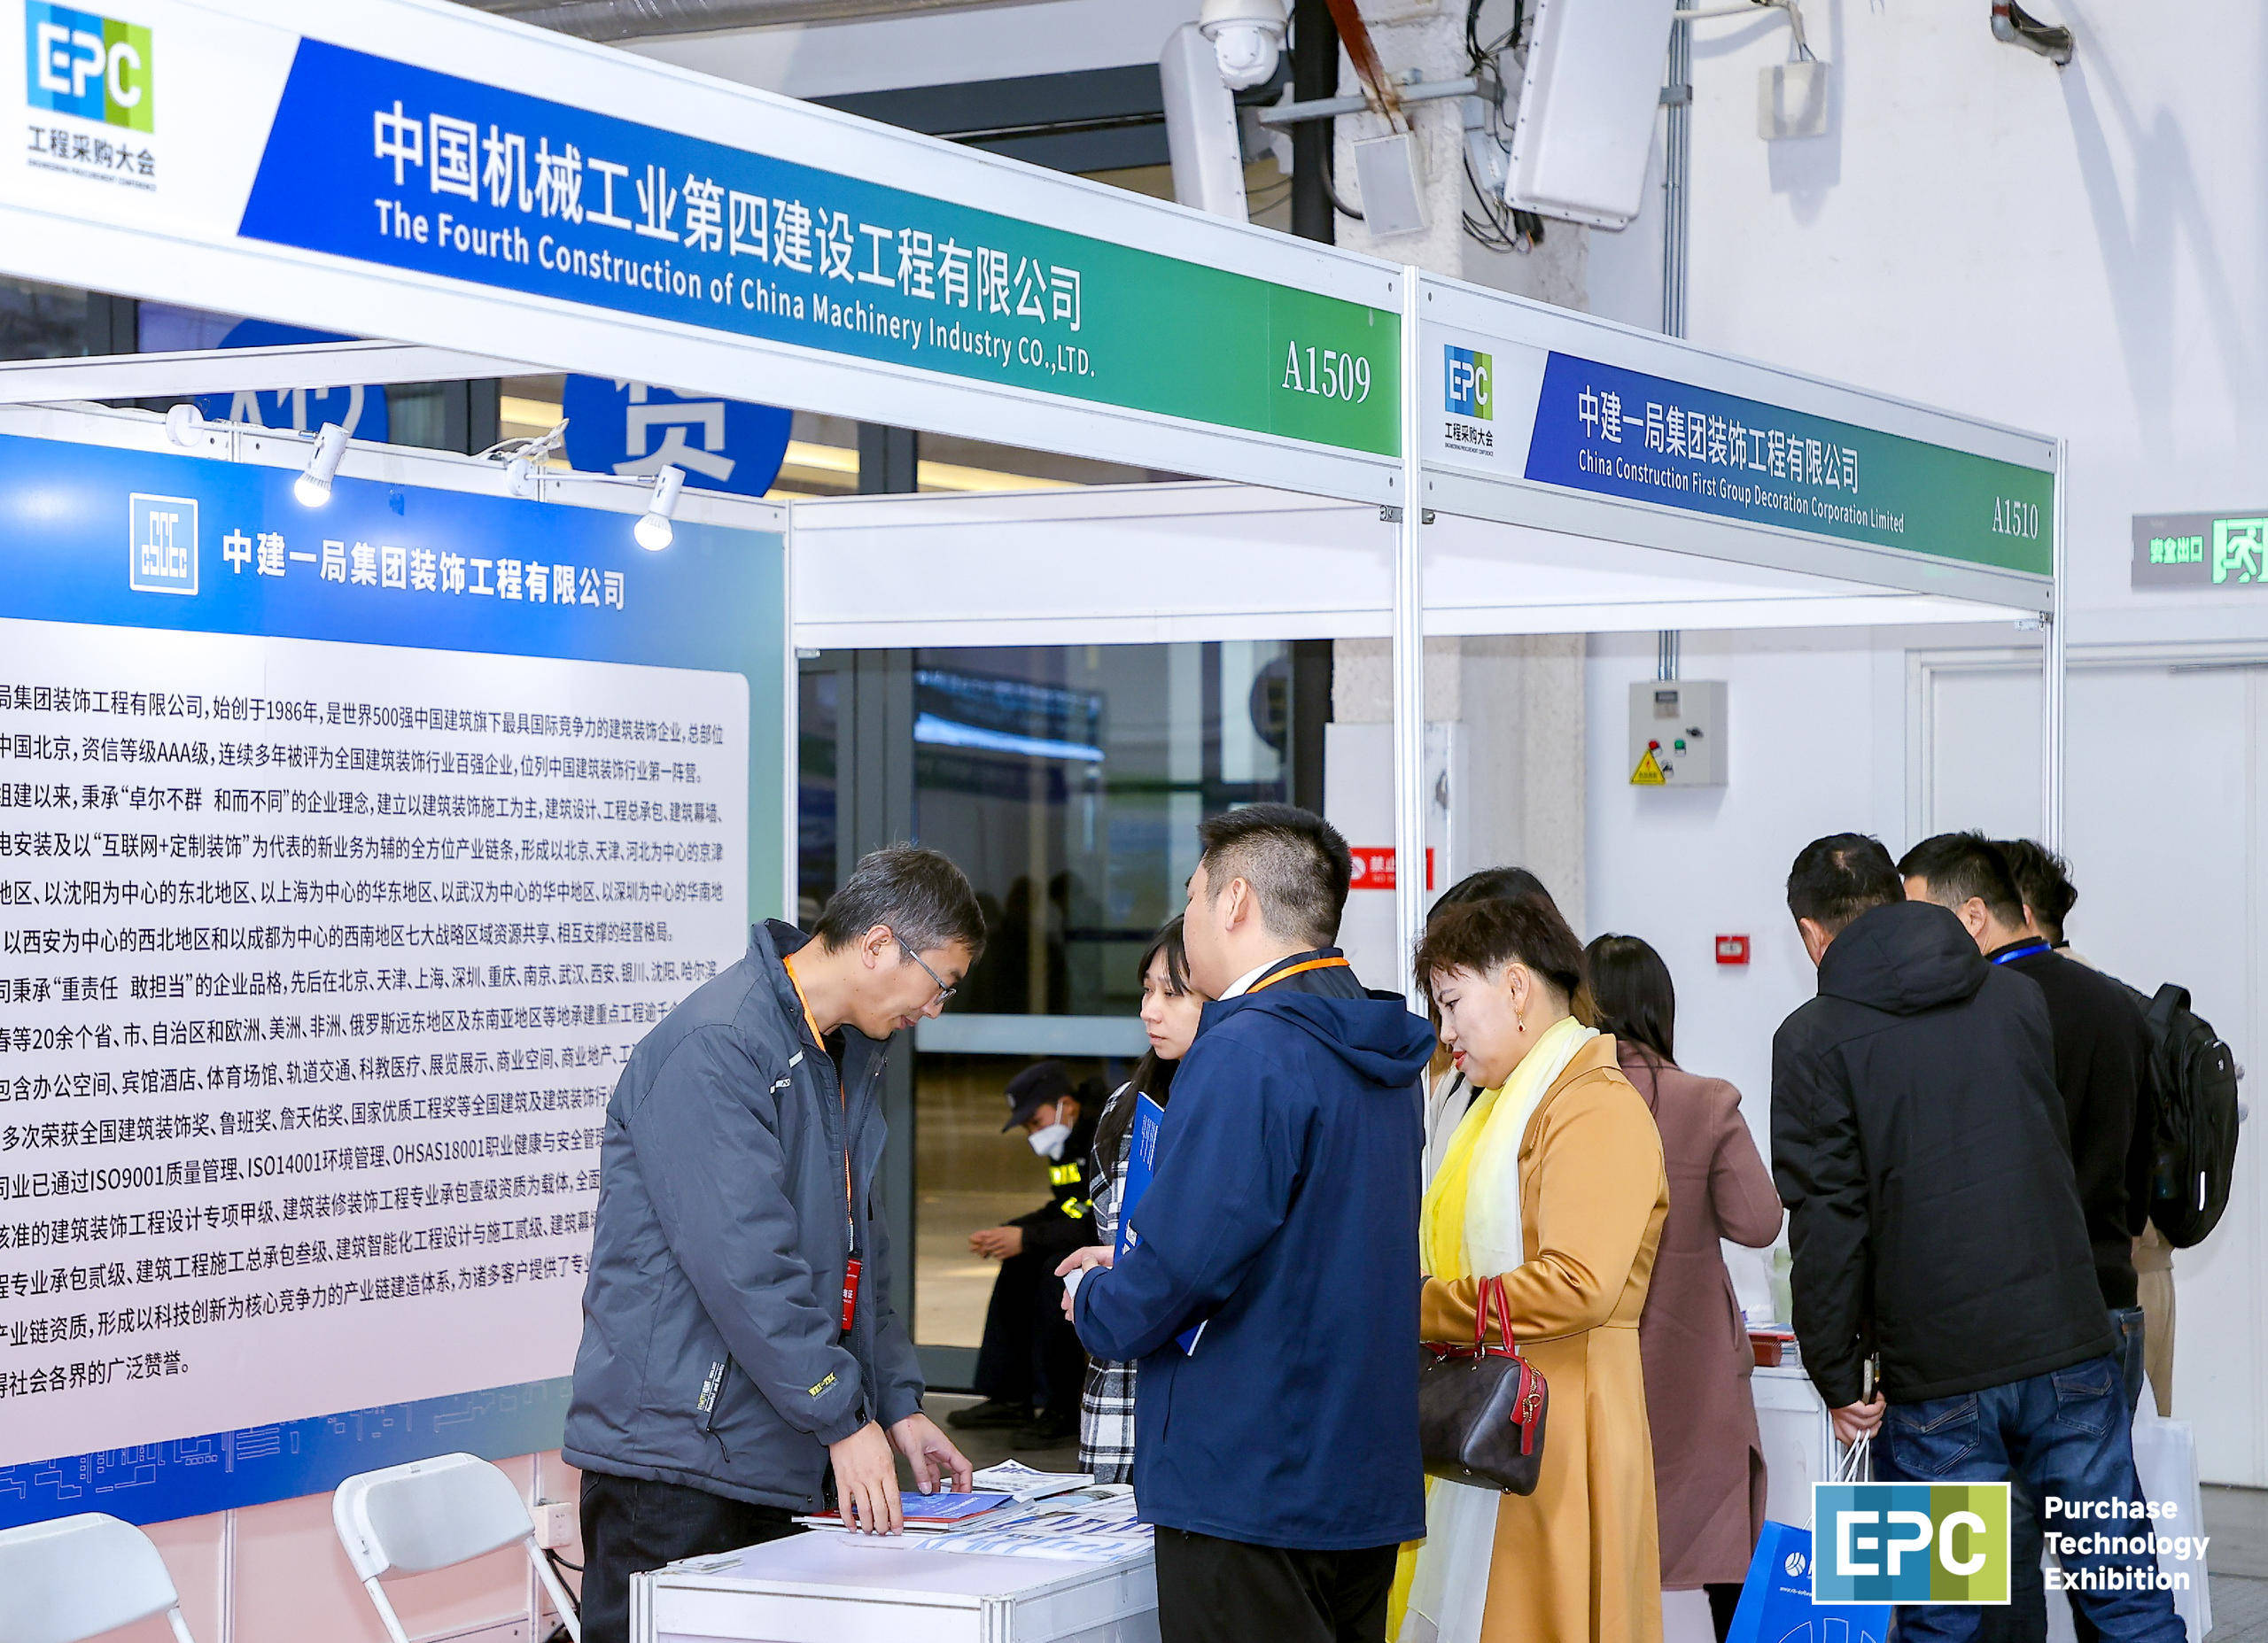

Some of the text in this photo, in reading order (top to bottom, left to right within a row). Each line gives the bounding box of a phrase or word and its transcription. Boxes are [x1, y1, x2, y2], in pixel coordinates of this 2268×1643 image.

[38, 21, 142, 108] EPC
[27, 125, 155, 176] 工程采购大会
[373, 100, 1082, 331] 中国机械工业第四建设工程有限公司
[374, 198, 1097, 378] The Fourth Construction of China Machinery Industry CO.,LTD.
[1281, 340, 1371, 404] A1509
[1449, 359, 1488, 406] EPC
[1445, 422, 1493, 447] 工程采购大会
[1578, 384, 1859, 494] 中建一局集团装饰工程有限公司
[1578, 449, 1905, 534] China Construction First Group Decoration Corporation Limited
[1992, 496, 2039, 540] A1510
[222, 528, 625, 610] 中建一局集团装饰工程有限公司
